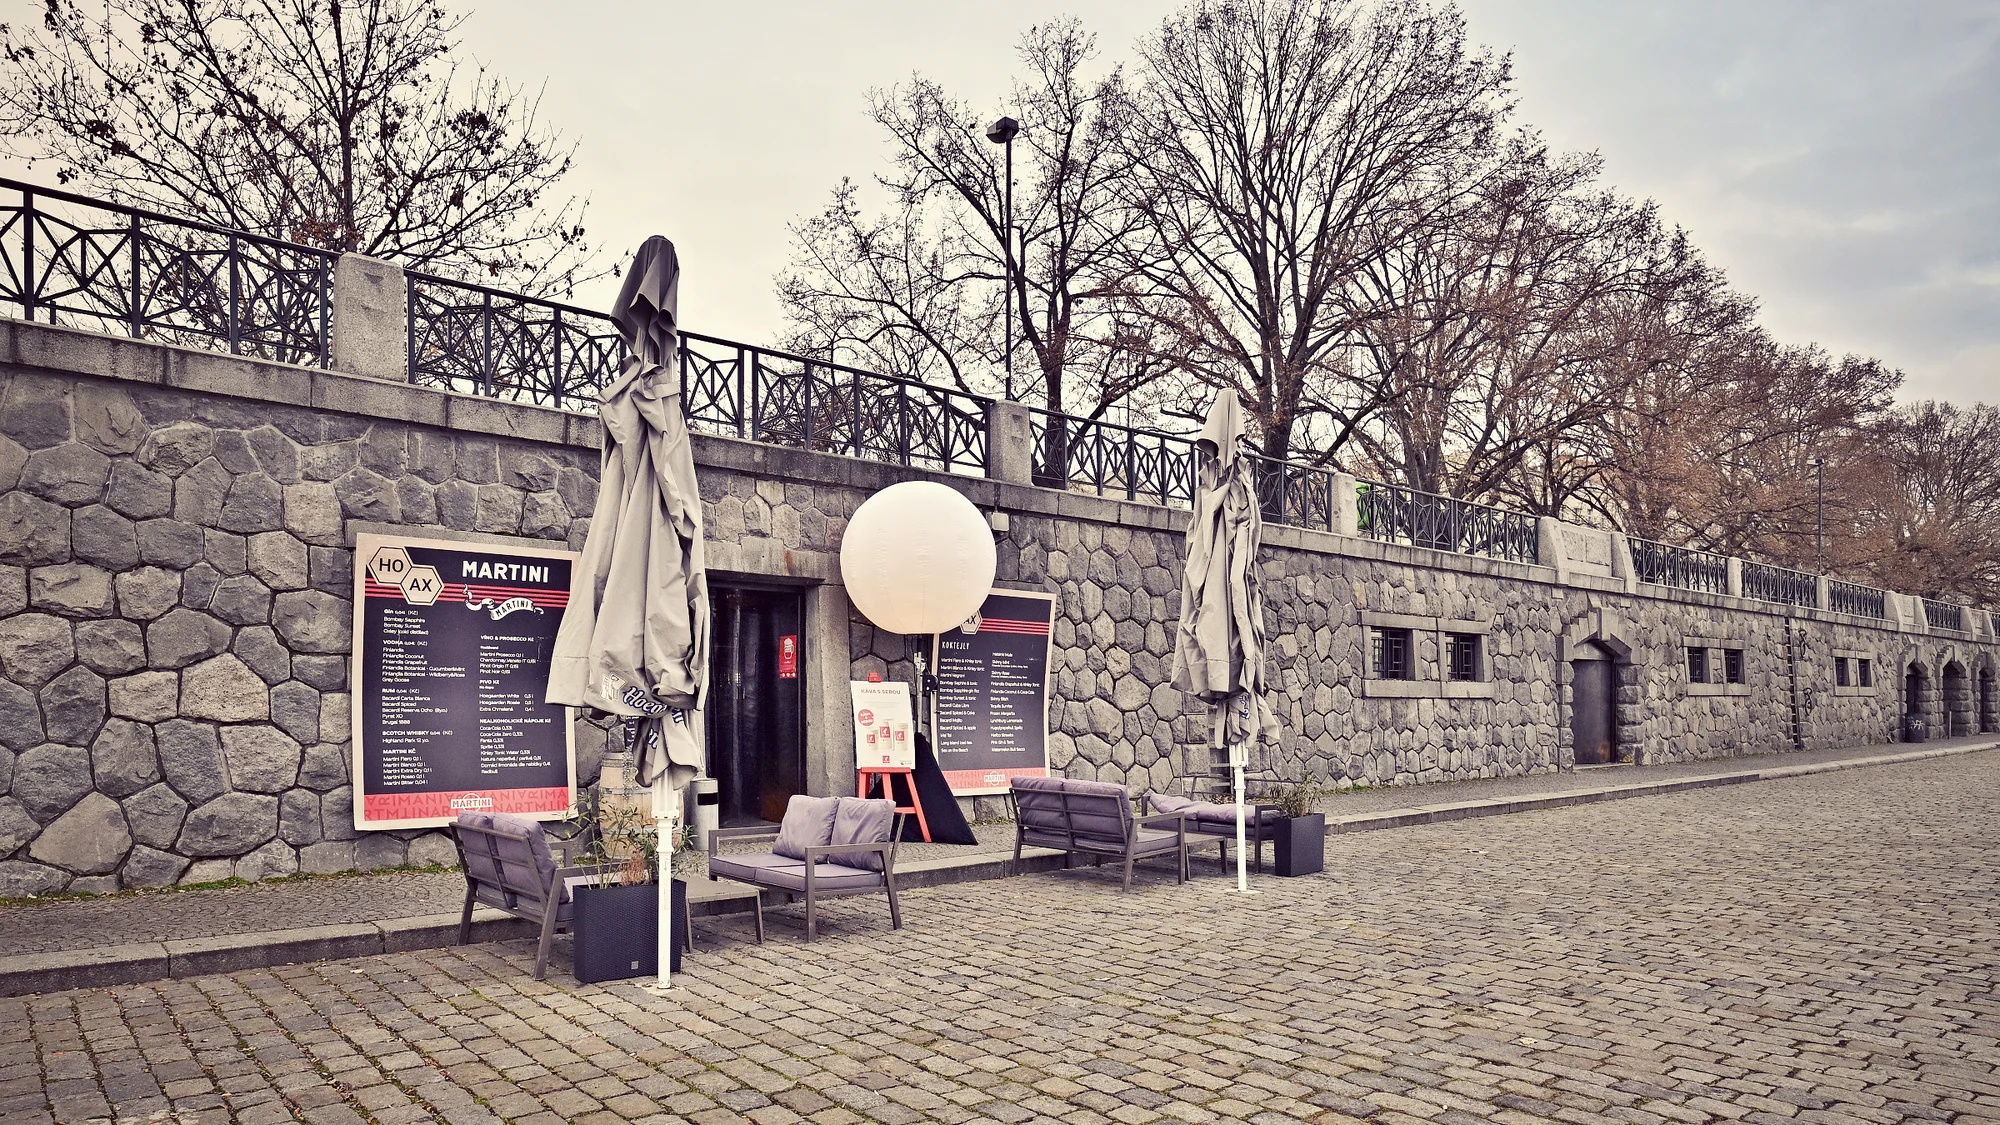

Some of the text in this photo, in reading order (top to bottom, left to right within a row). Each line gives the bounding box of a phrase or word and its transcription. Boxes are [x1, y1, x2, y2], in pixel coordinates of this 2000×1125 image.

[379, 558, 404, 573] HO
[462, 560, 549, 583] MARTINI
[409, 578, 433, 593] AX
[496, 600, 529, 617] MARTINI
[942, 641, 970, 650] KOKTEJLY
[622, 686, 668, 716] Hoeg
[452, 798, 491, 808] MARTINI
